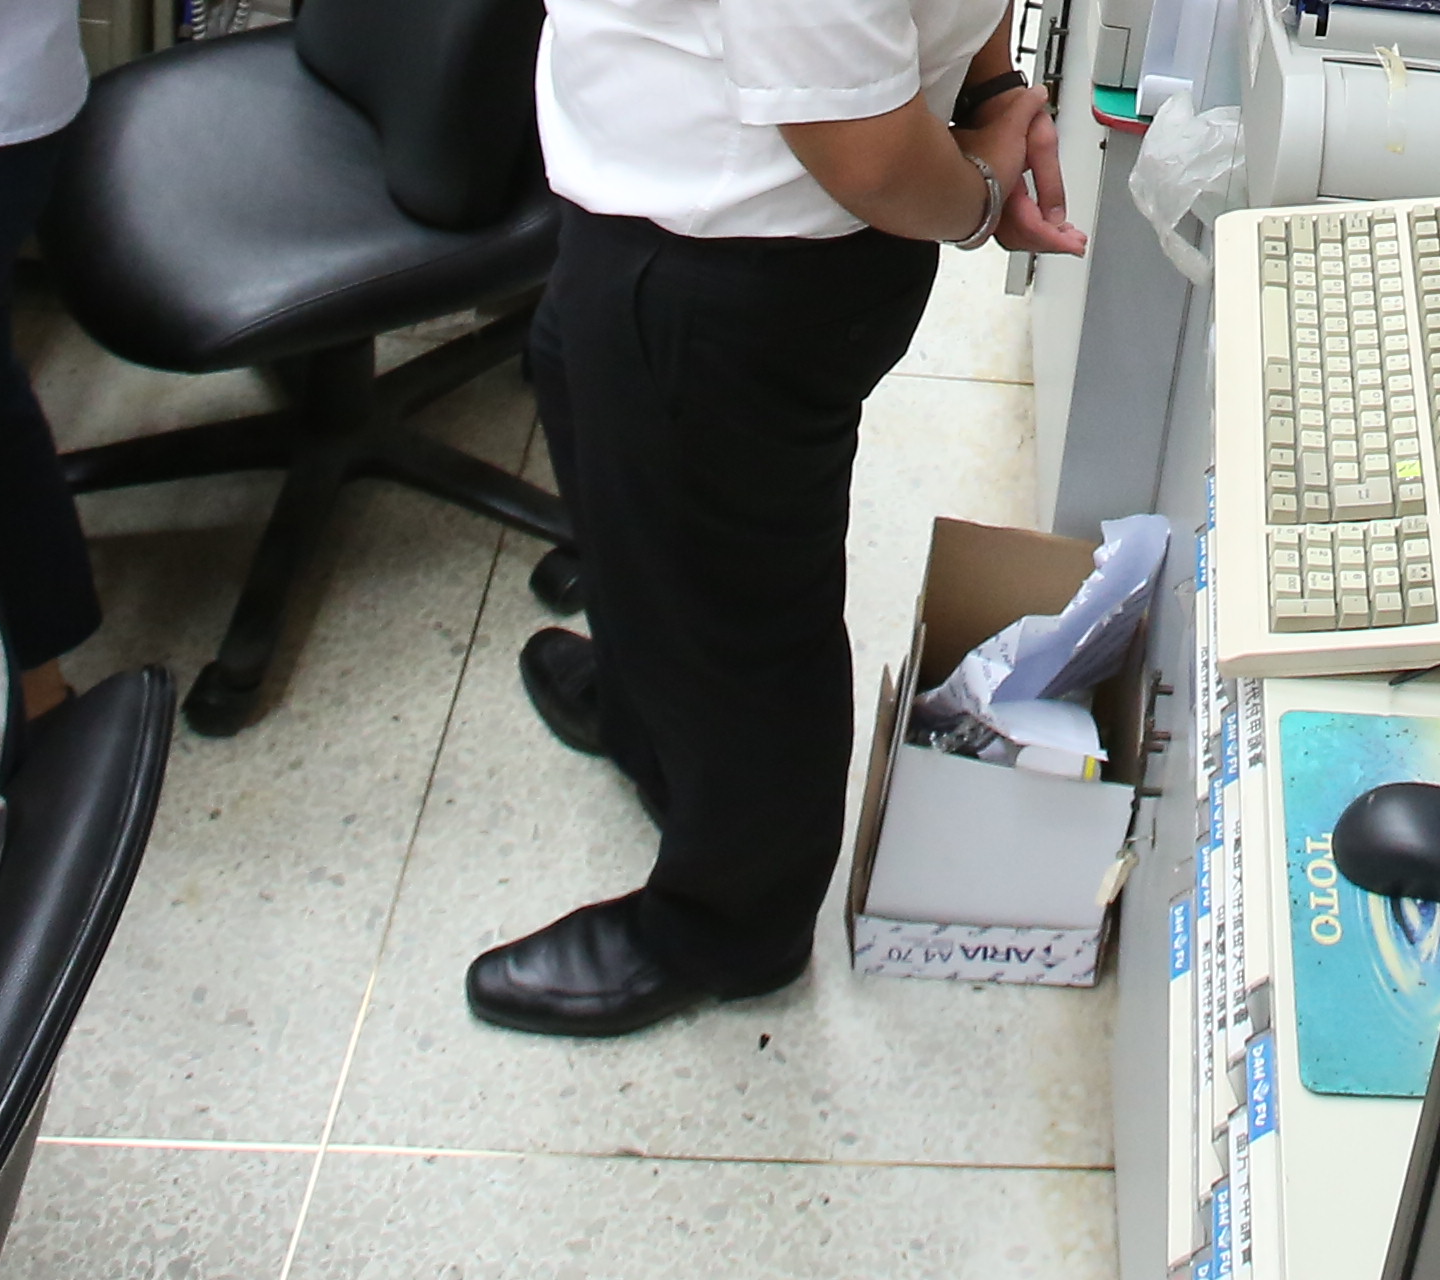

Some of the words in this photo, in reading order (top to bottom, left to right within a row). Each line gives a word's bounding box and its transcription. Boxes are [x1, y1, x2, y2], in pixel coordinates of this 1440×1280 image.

[1306, 831, 1343, 946] TOTO
[924, 947, 953, 964] A4
[960, 943, 1035, 964] ARIA
[1251, 1042, 1266, 1081] DAH
[1254, 1105, 1268, 1128] FU
